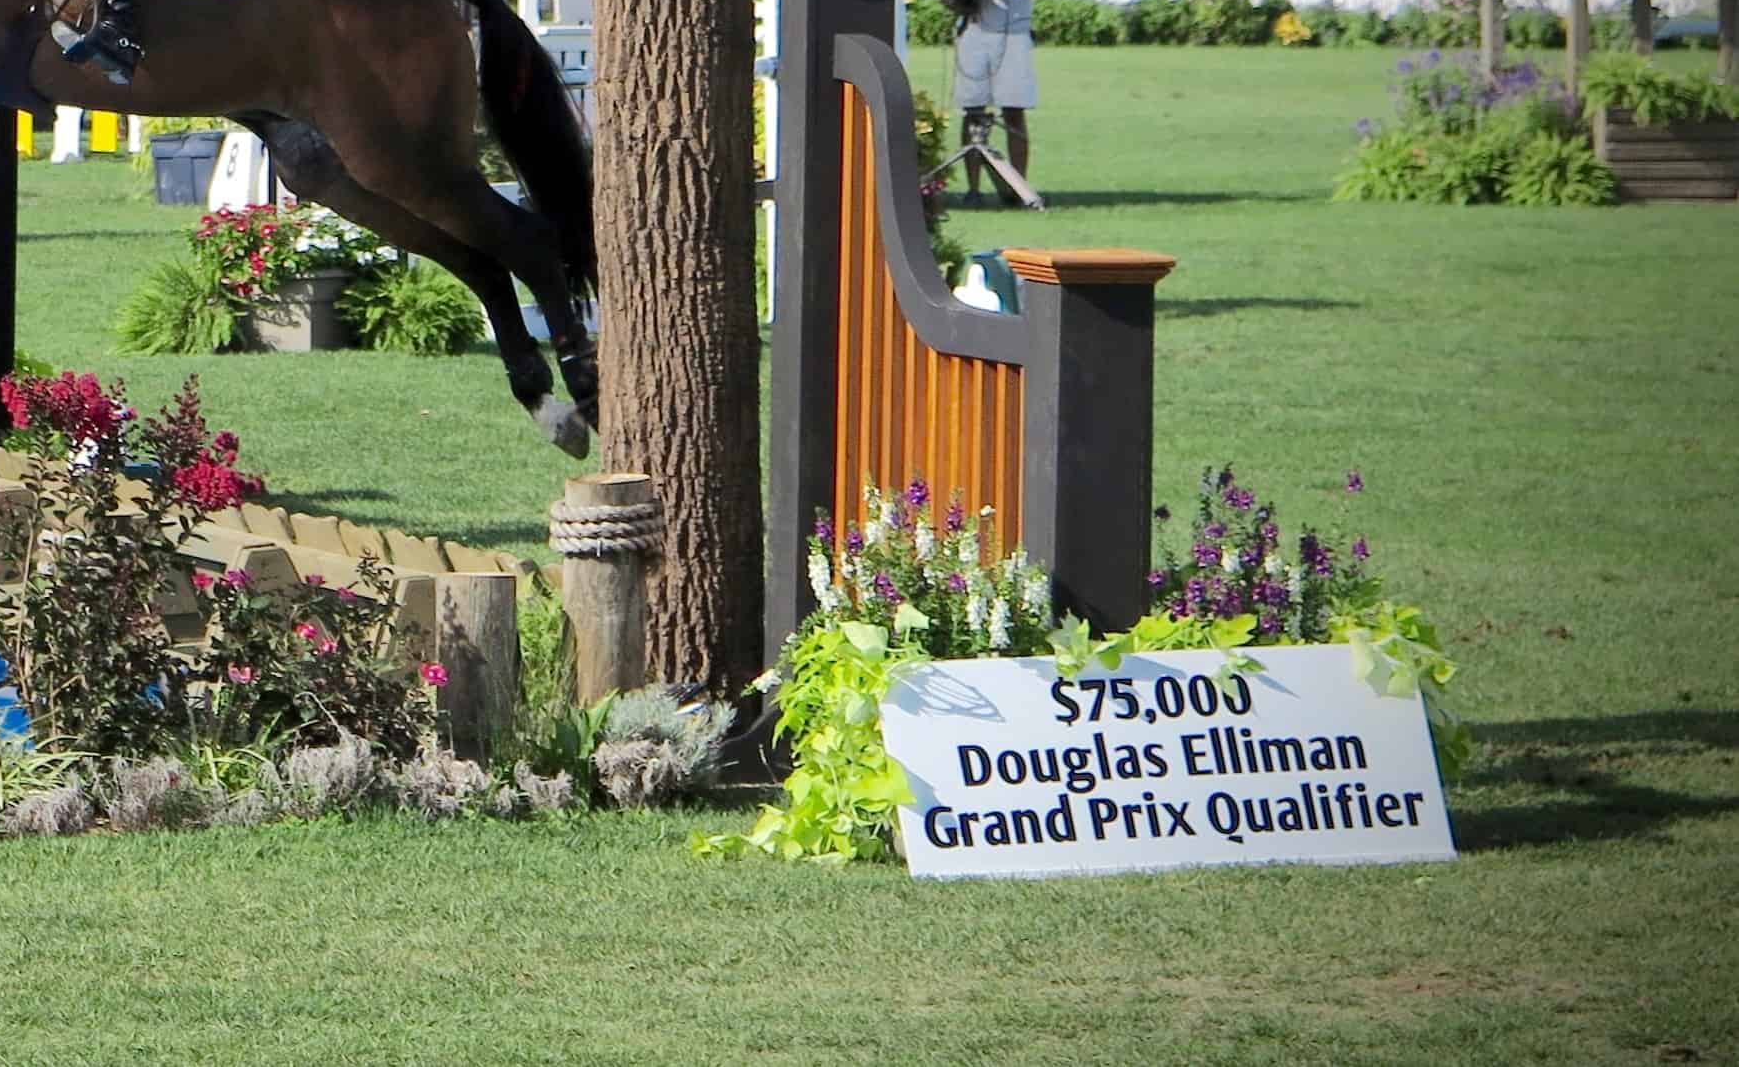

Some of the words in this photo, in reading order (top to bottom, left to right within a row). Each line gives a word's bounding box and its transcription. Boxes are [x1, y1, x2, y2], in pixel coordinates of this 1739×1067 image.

[1051, 674, 1253, 727] $75,000
[957, 732, 1168, 795] Douglas
[1180, 726, 1368, 776] Elliman
[923, 792, 1077, 850] Grand
[1087, 791, 1197, 841] Prix
[1206, 781, 1425, 845] Qualifier
